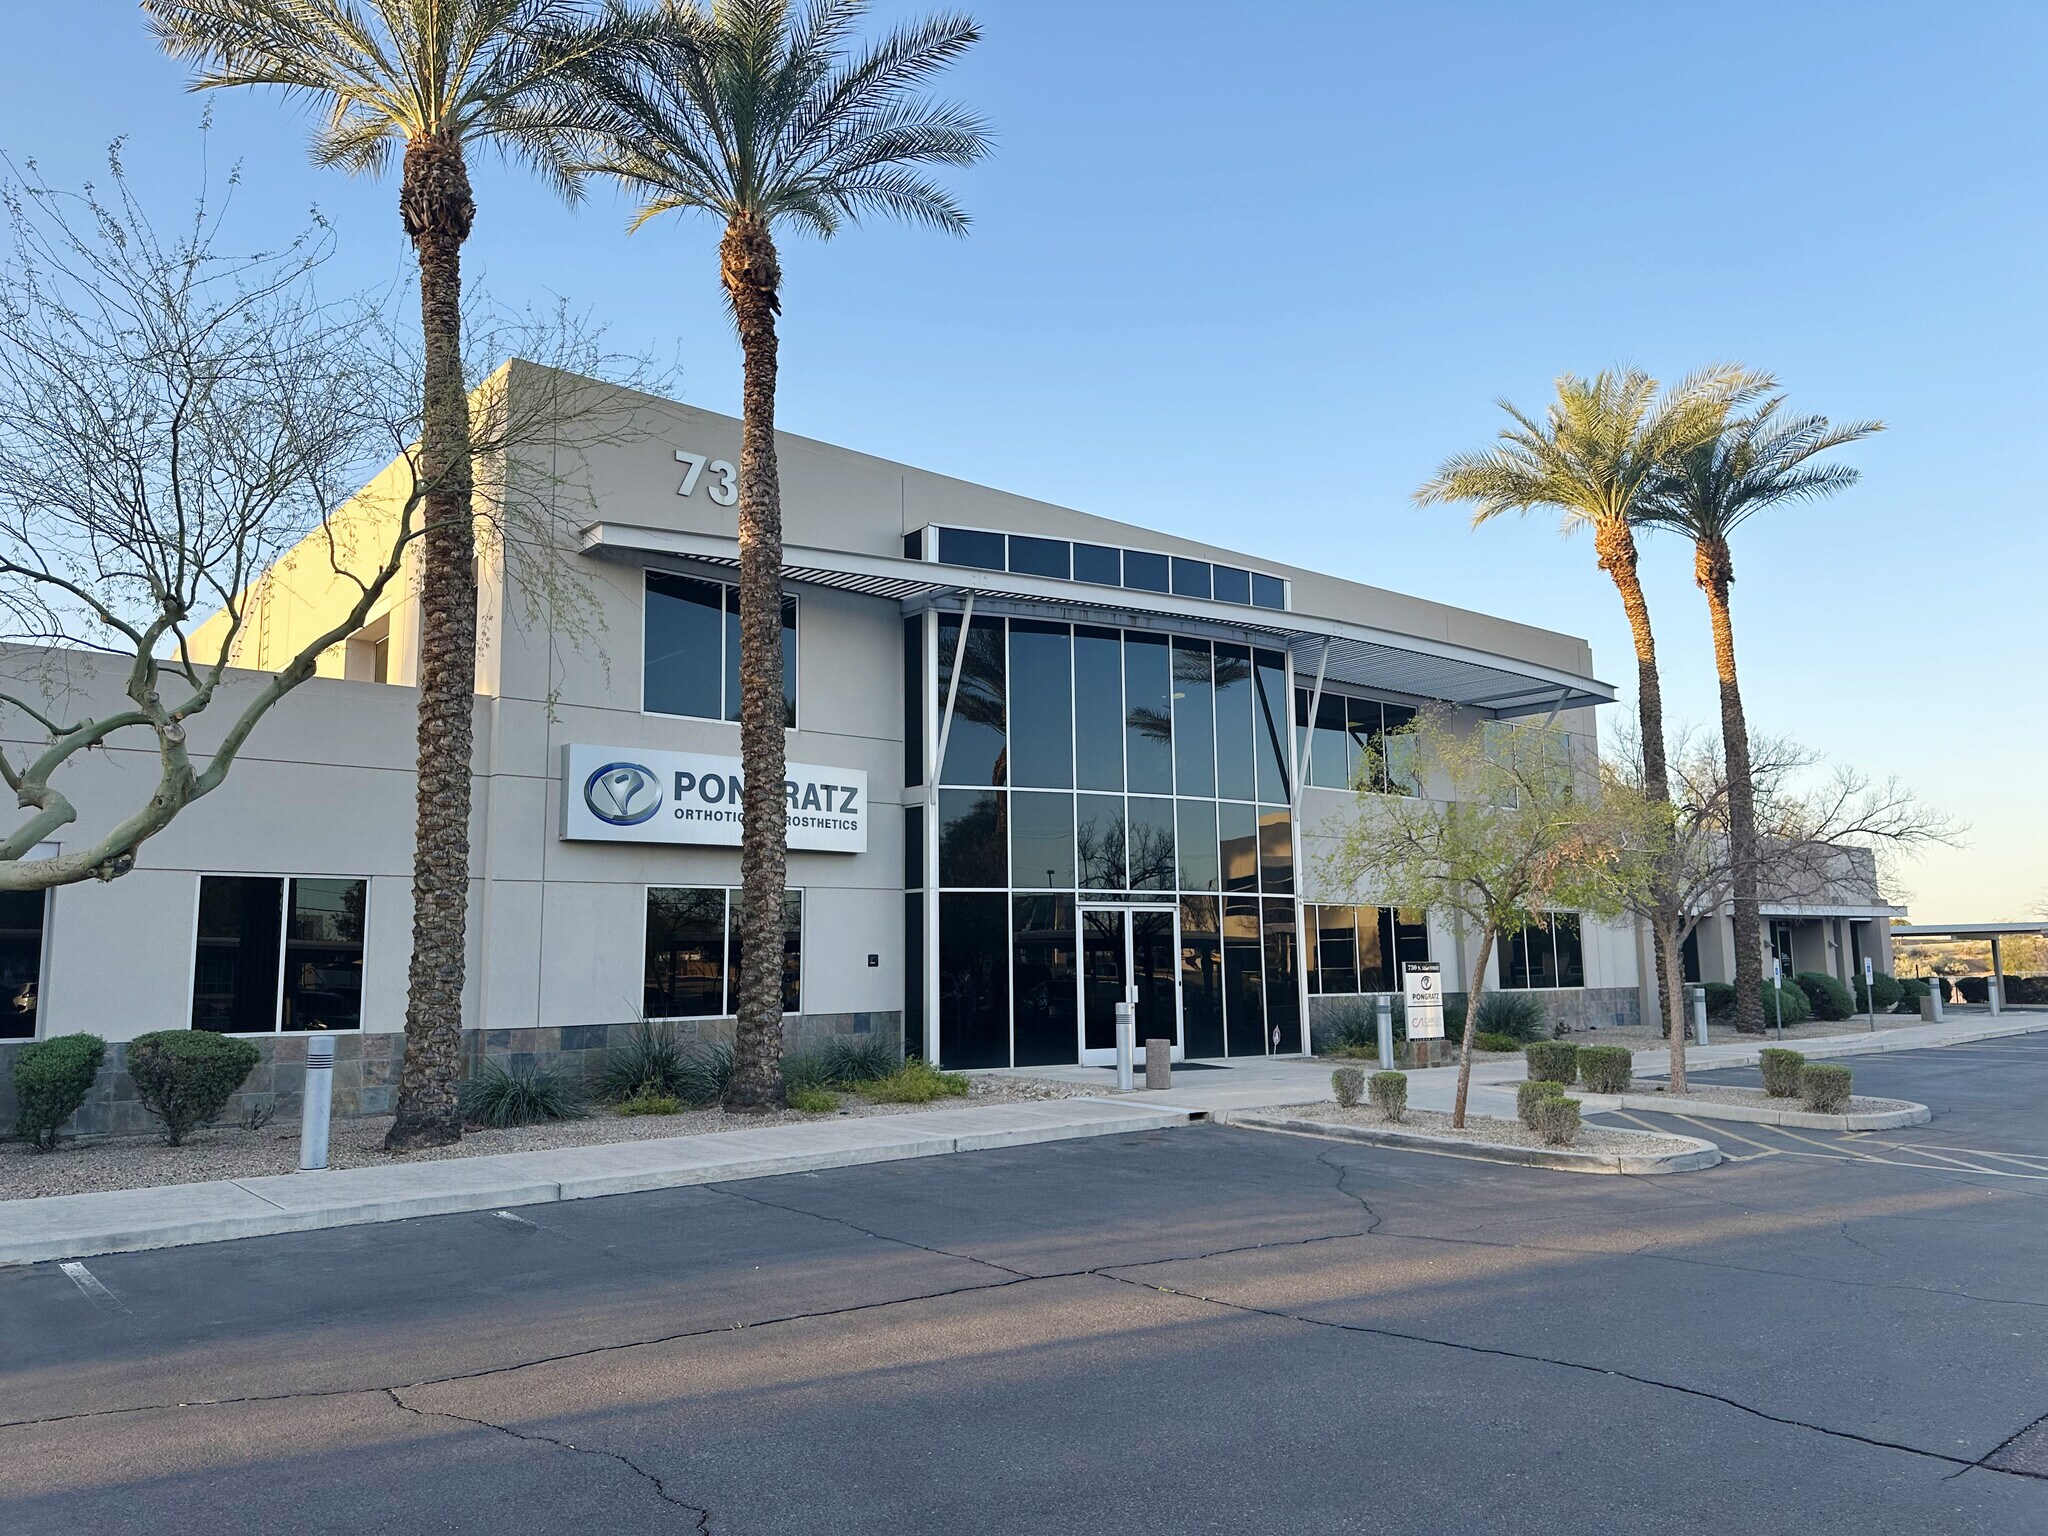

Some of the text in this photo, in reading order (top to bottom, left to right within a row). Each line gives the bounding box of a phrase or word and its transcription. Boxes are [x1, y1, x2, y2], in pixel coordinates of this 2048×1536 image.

[675, 449, 739, 507] 73
[674, 771, 858, 814] PONRATZ
[674, 808, 858, 831] ORTHOTIC ROSTHETICS
